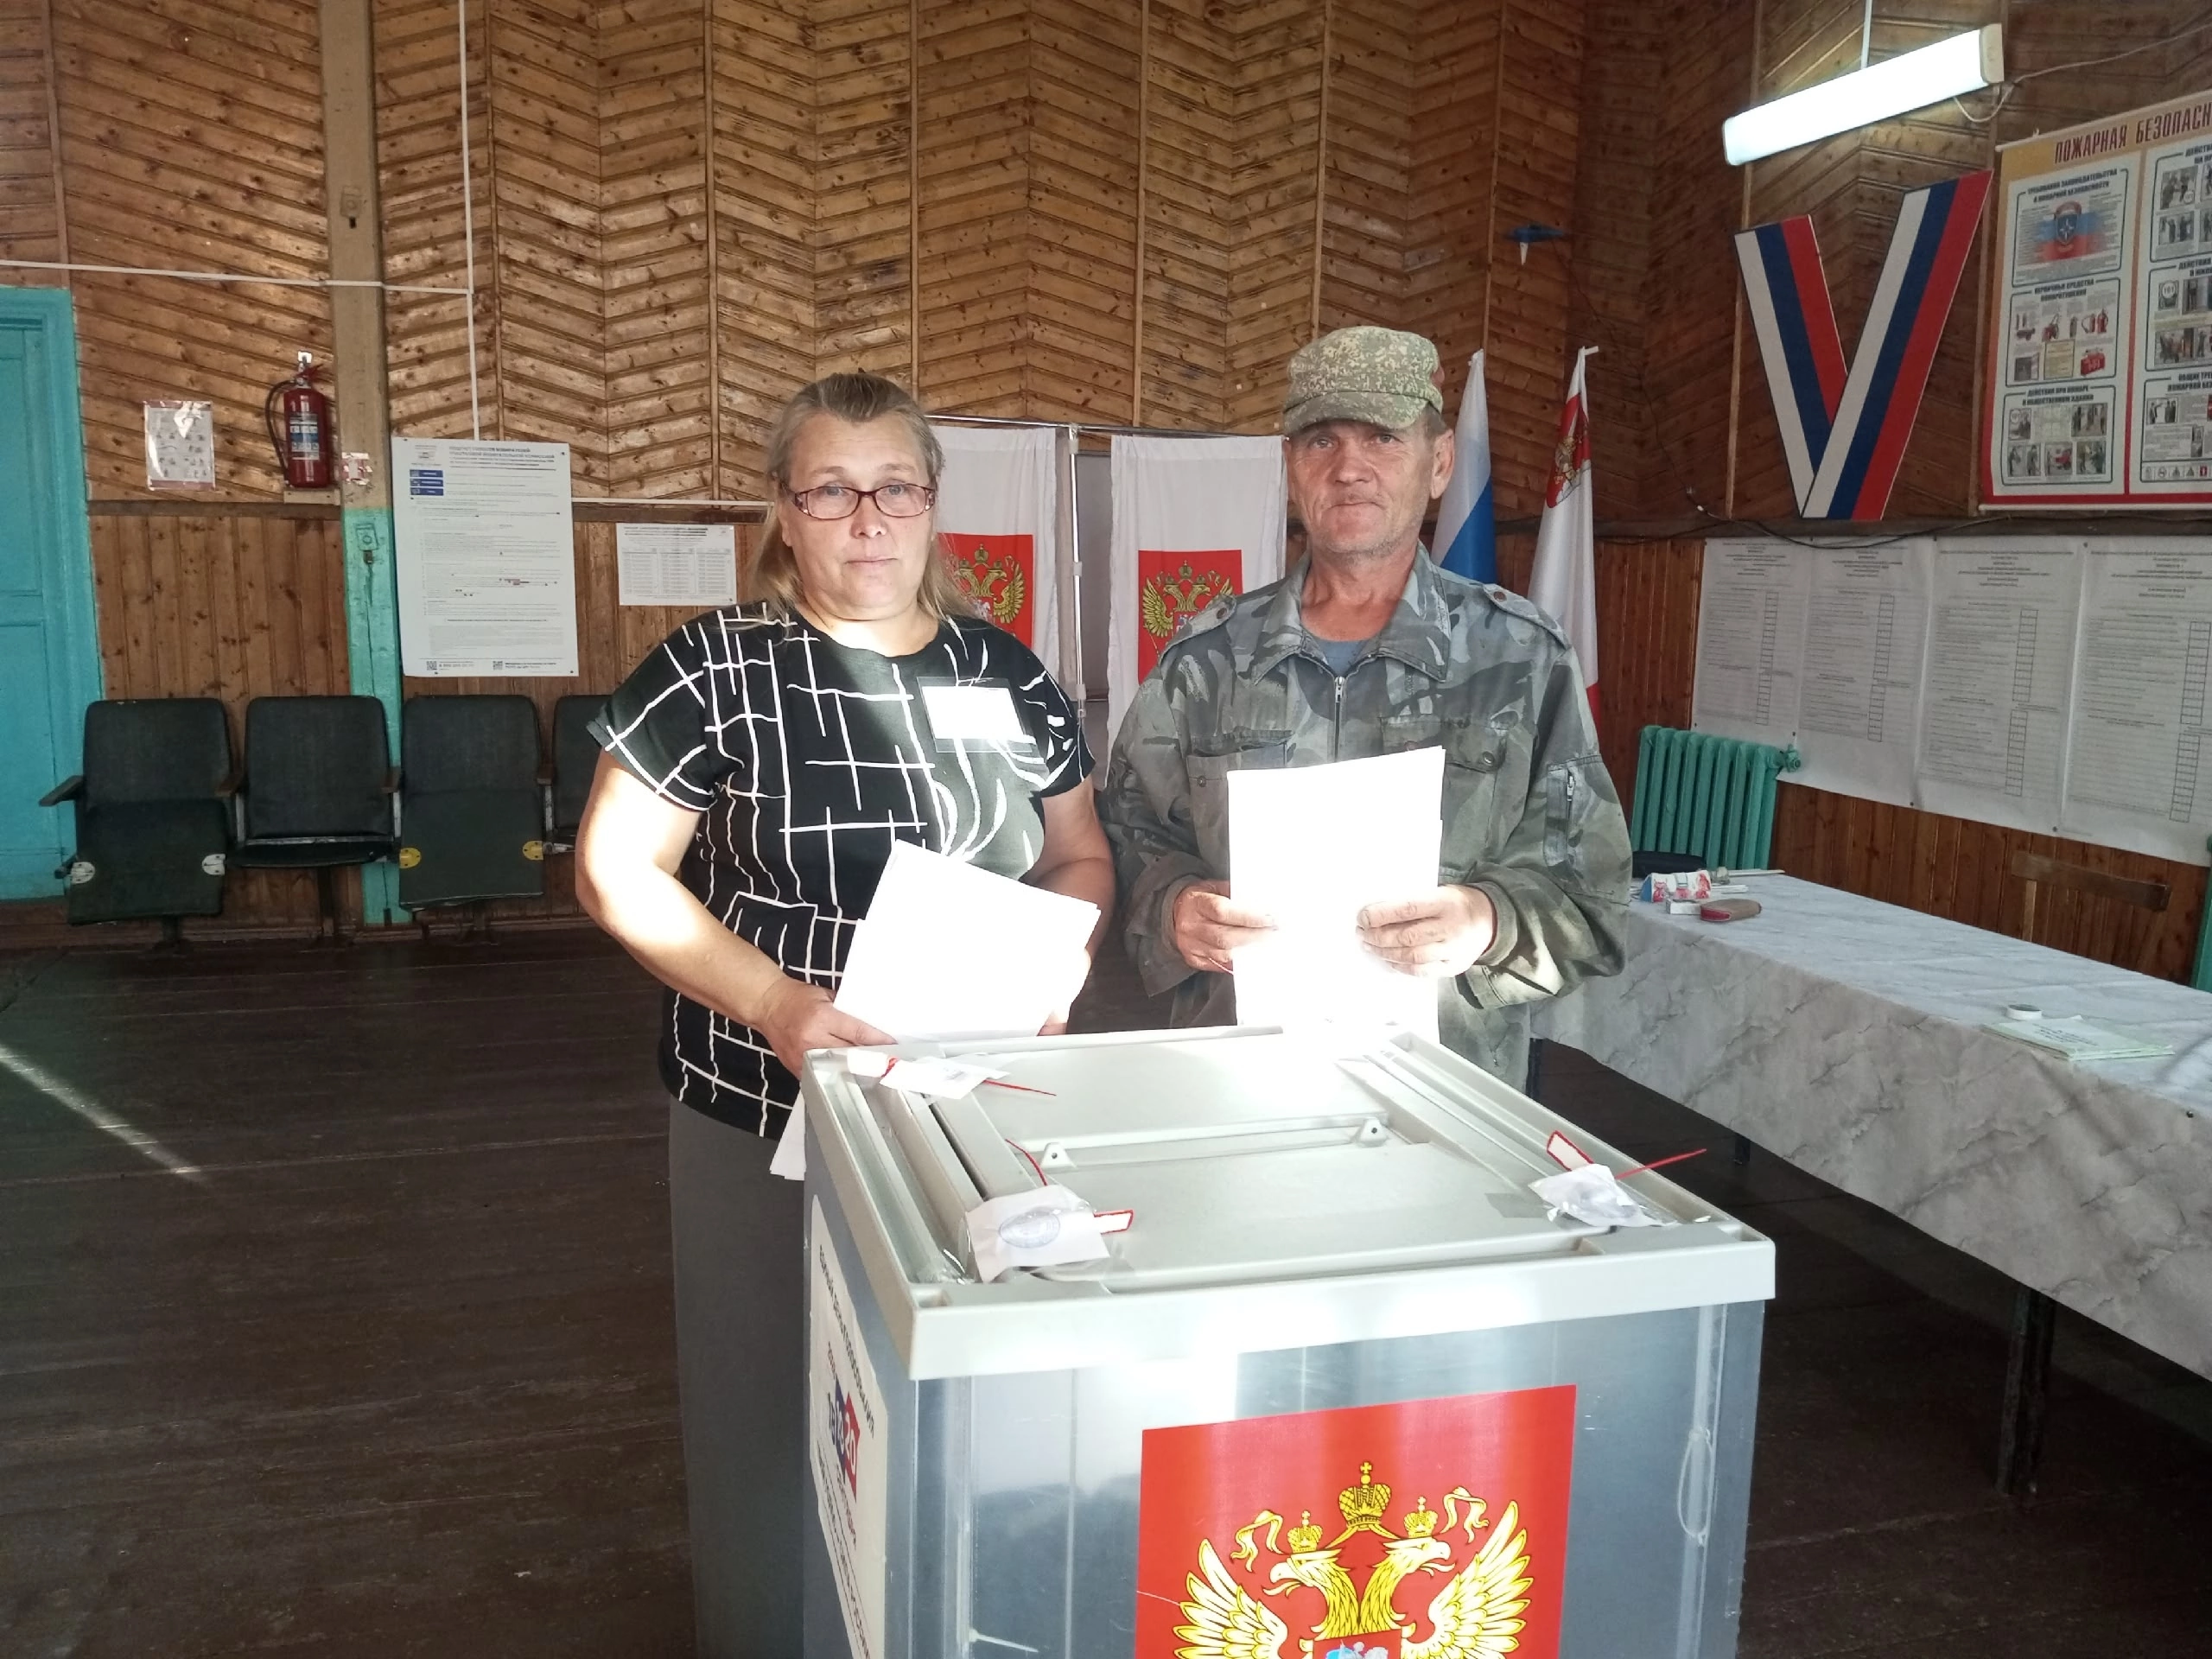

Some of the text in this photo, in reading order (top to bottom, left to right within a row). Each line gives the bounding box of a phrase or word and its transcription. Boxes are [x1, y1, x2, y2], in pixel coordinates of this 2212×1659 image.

[2055, 102, 2212, 164] ПОЖАРНАЯ БЕЗОПАСН
[845, 1411, 856, 1476] 20
